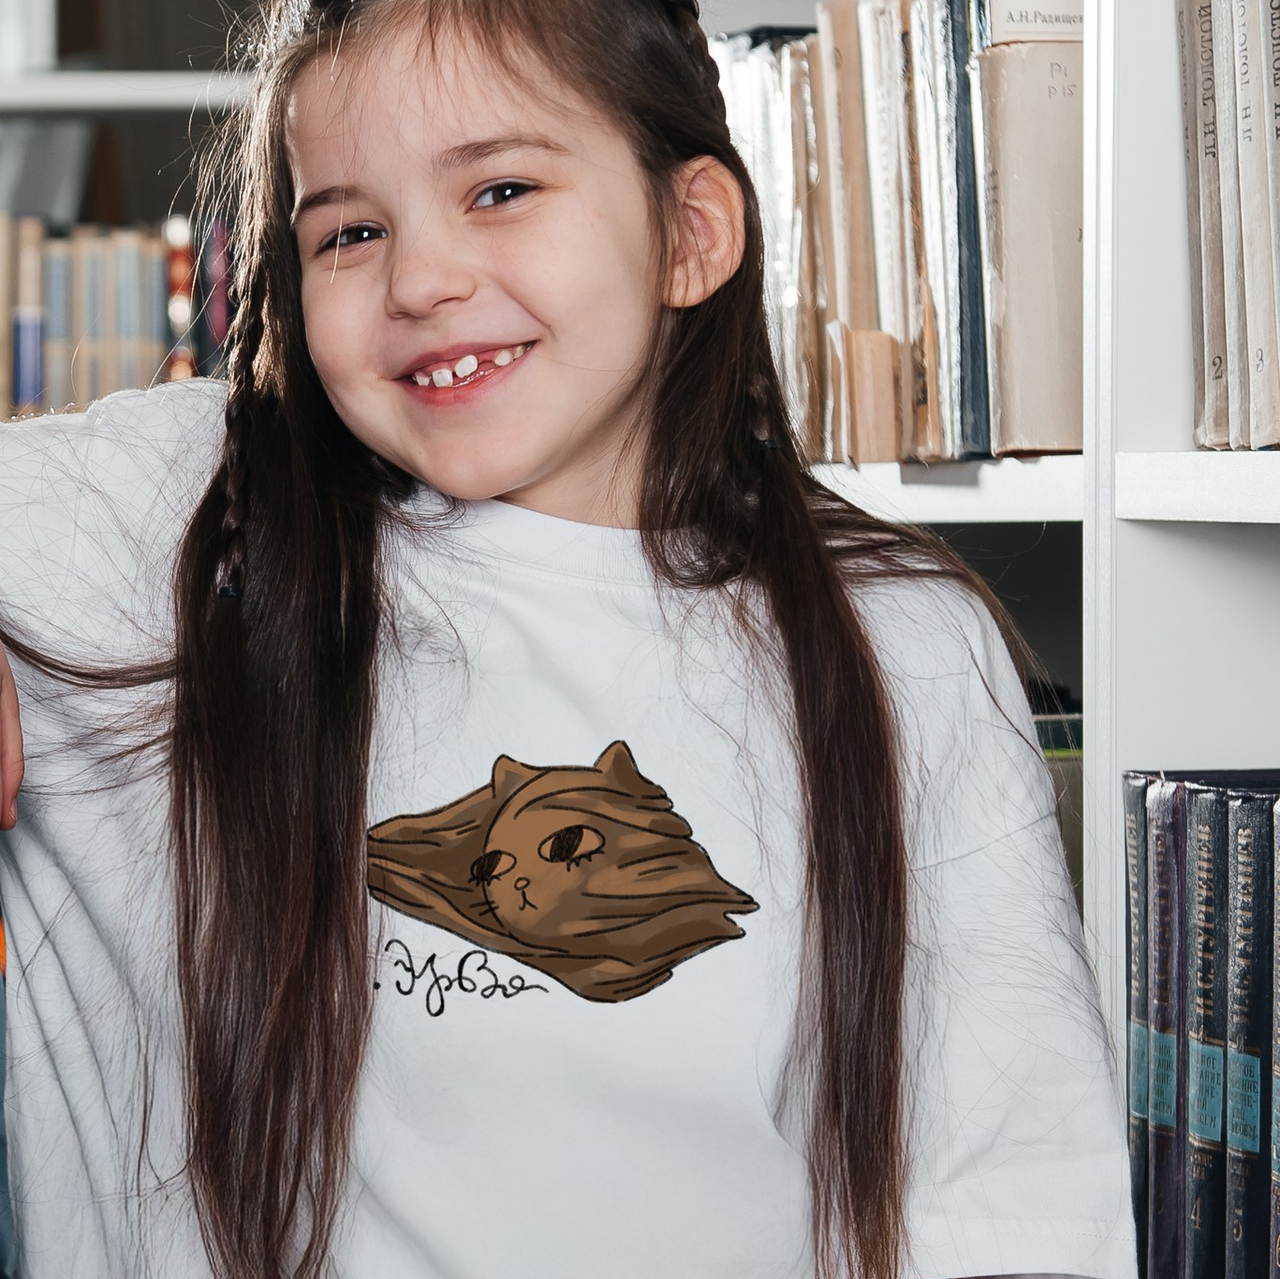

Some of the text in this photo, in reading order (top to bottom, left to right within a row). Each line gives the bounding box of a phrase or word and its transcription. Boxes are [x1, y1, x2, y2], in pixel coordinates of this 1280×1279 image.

[1198, 3, 1215, 107] ТОЛСТОЙ
[1212, 355, 1223, 381] 2
[1256, 348, 1265, 373] 3
[1195, 823, 1215, 963] ТУРГЕНЕВ
[1235, 827, 1253, 966] ТУРГЕНЕВ
[1191, 1196, 1202, 1230] 4
